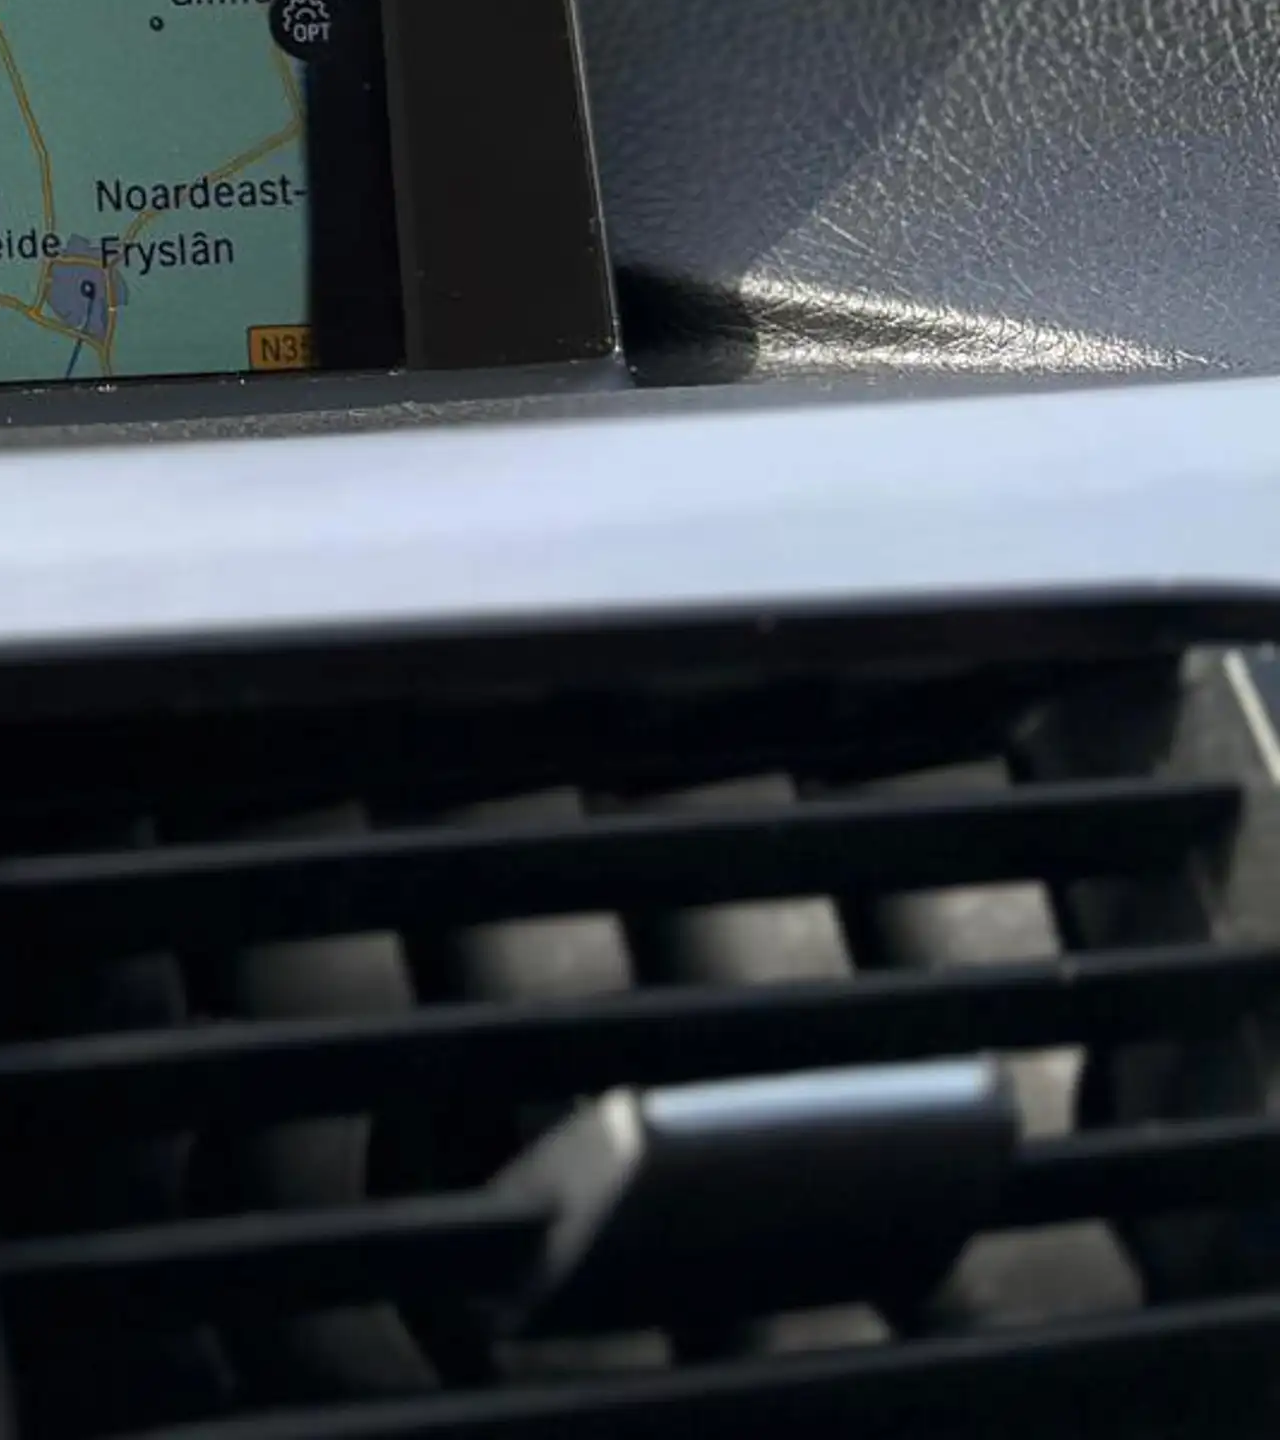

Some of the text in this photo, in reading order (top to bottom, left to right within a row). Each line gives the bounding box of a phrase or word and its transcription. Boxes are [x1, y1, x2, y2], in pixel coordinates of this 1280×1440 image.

[293, 21, 332, 43] OPT
[95, 173, 308, 212] Noardeast-
[101, 233, 234, 276] Fryslân
